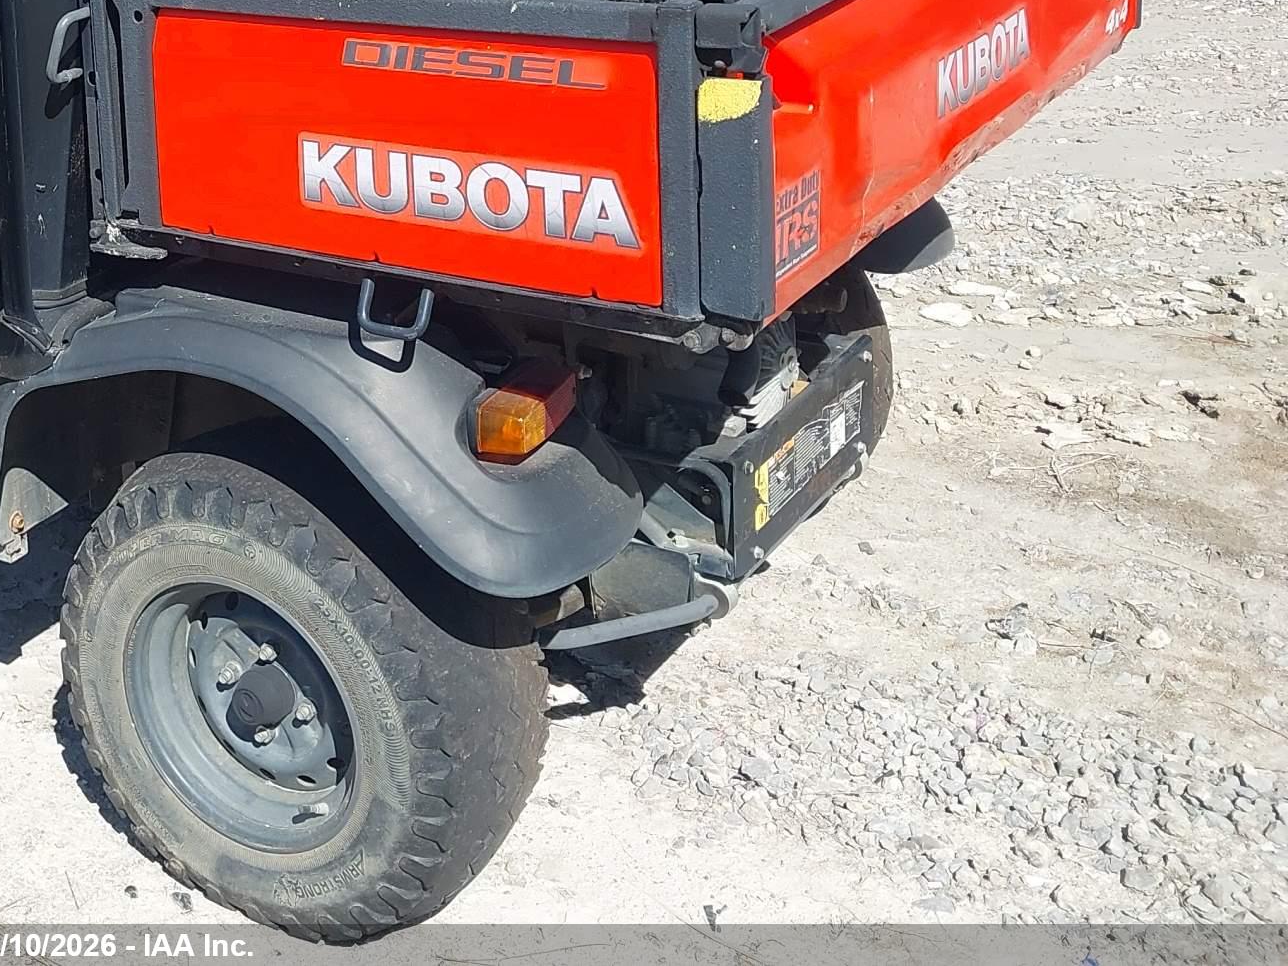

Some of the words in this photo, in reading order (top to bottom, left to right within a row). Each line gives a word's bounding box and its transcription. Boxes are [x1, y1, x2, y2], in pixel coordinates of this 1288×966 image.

[342, 39, 607, 89] DIESEL
[937, 8, 1031, 119] KUBOTA
[302, 139, 641, 249] KUBOTA
[295, 846, 365, 899] ARMSTRONG
